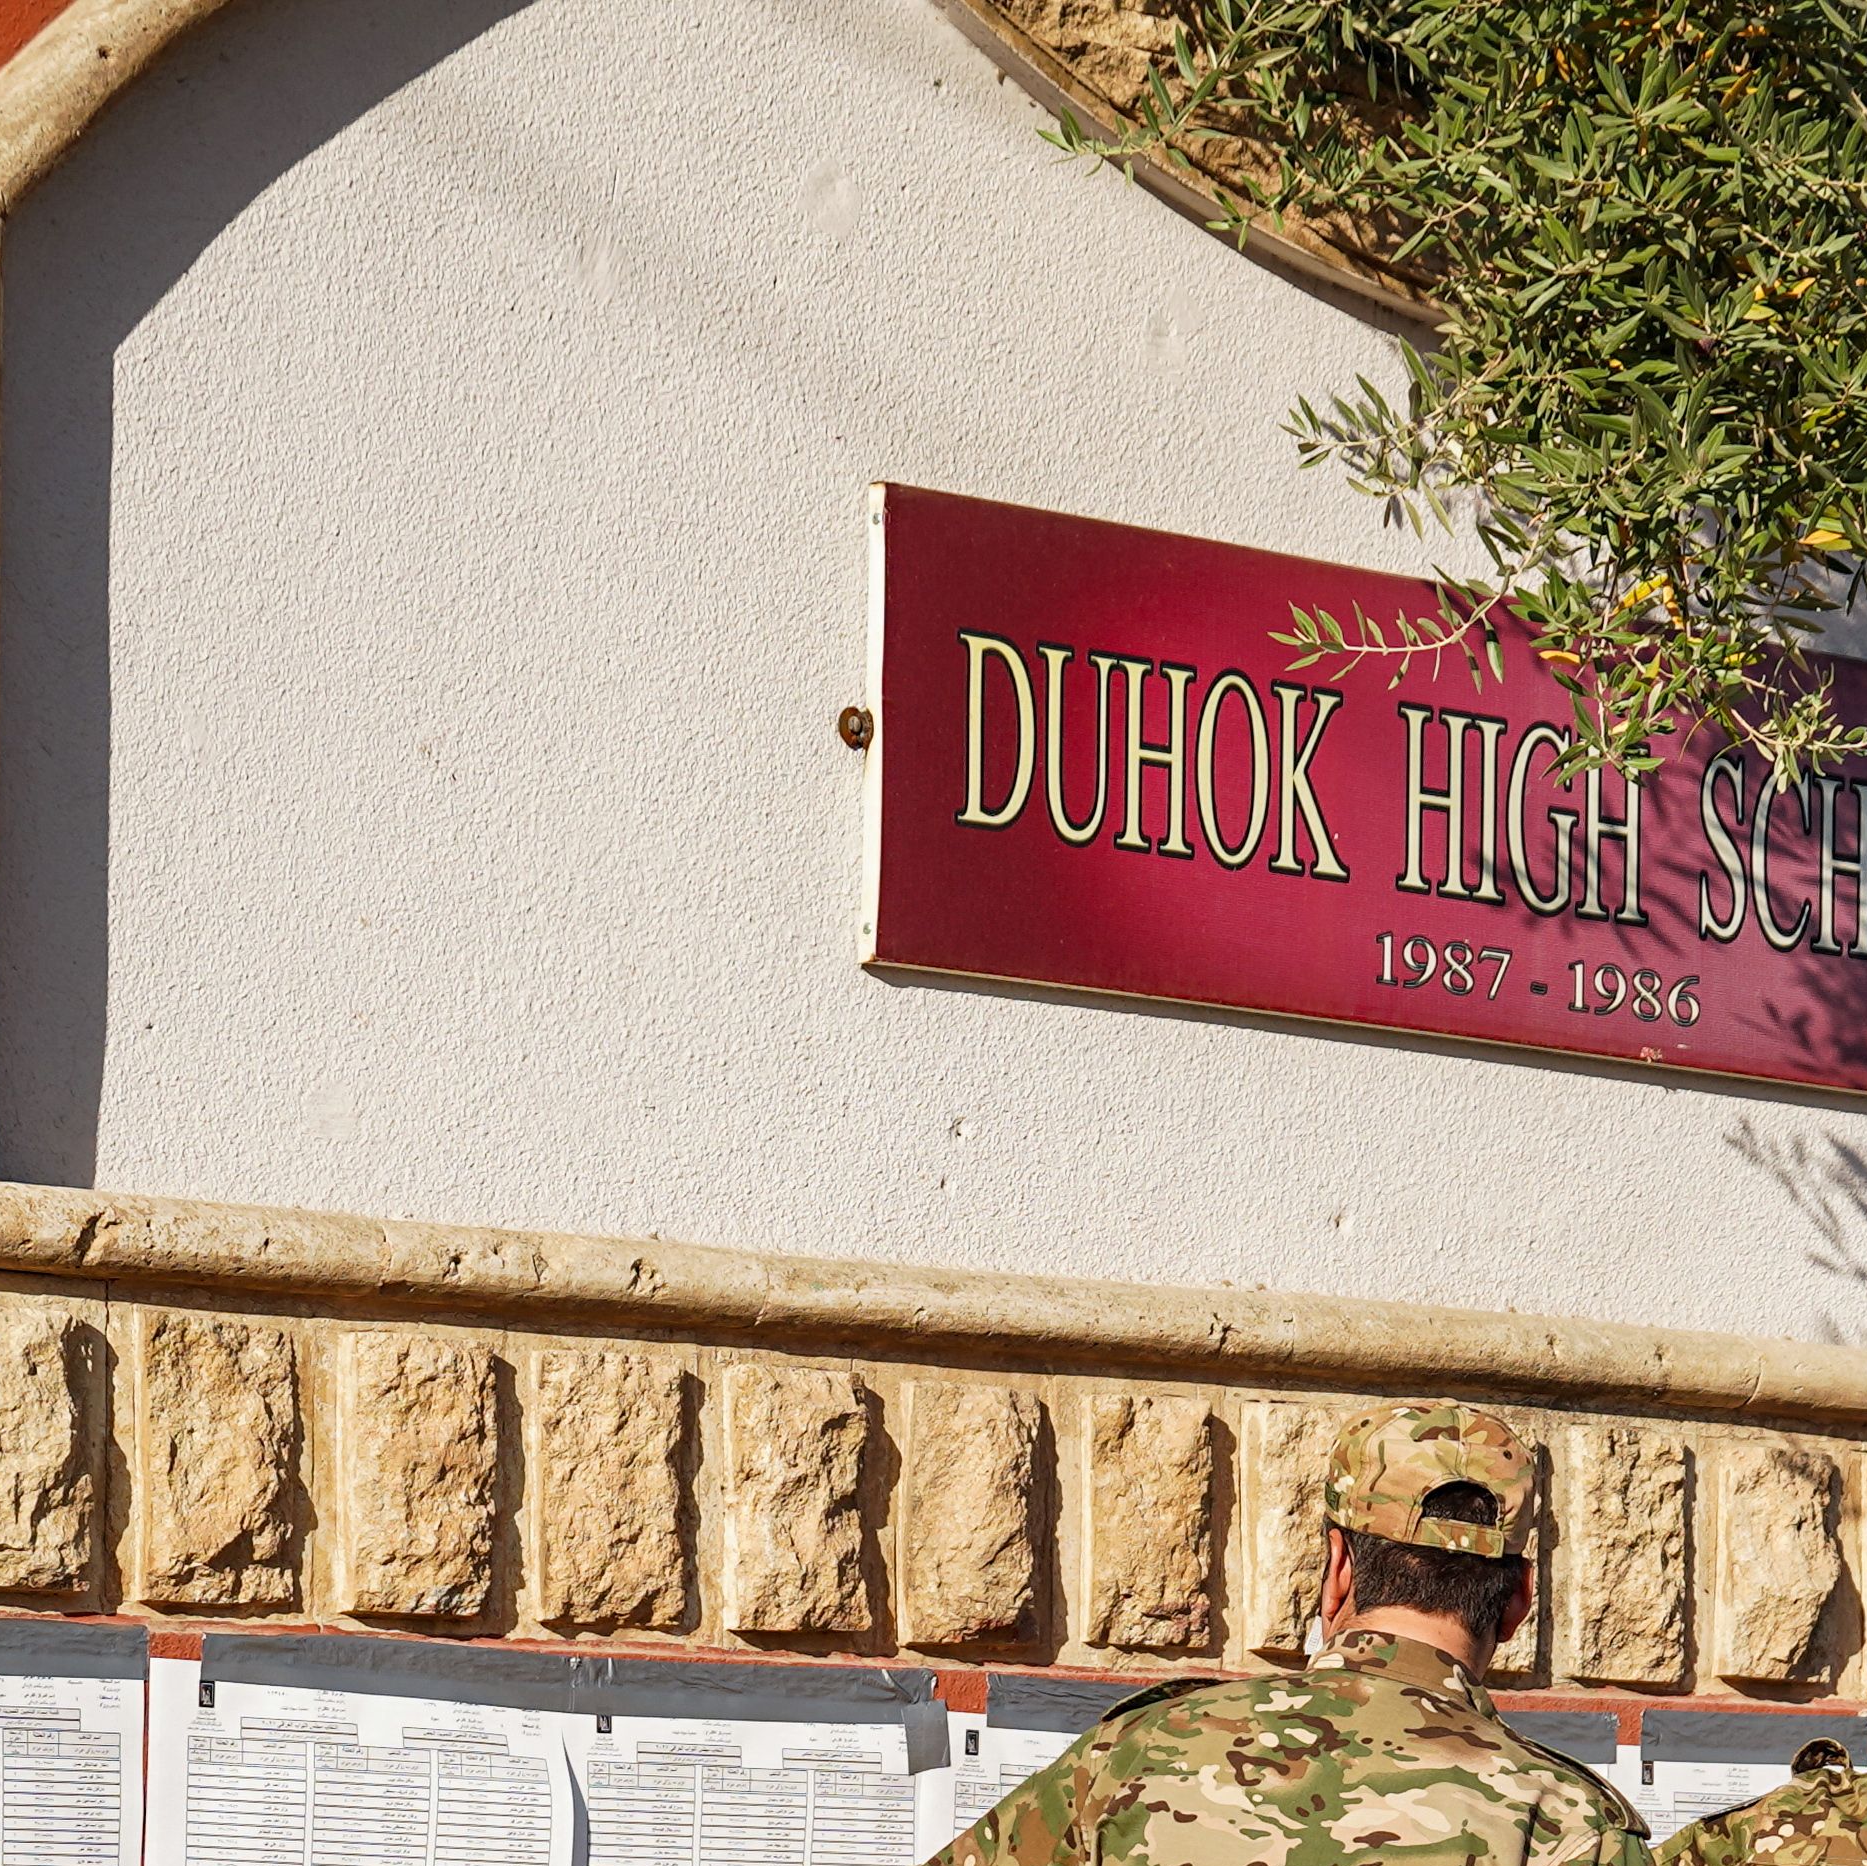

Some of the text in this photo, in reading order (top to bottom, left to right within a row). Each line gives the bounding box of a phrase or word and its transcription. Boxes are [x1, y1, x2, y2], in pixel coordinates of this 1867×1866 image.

[955, 627, 1350, 884] DUHOK
[1395, 700, 1649, 930] HIGH
[1375, 930, 1512, 1004] 1987
[1566, 959, 1701, 1028] 1986
